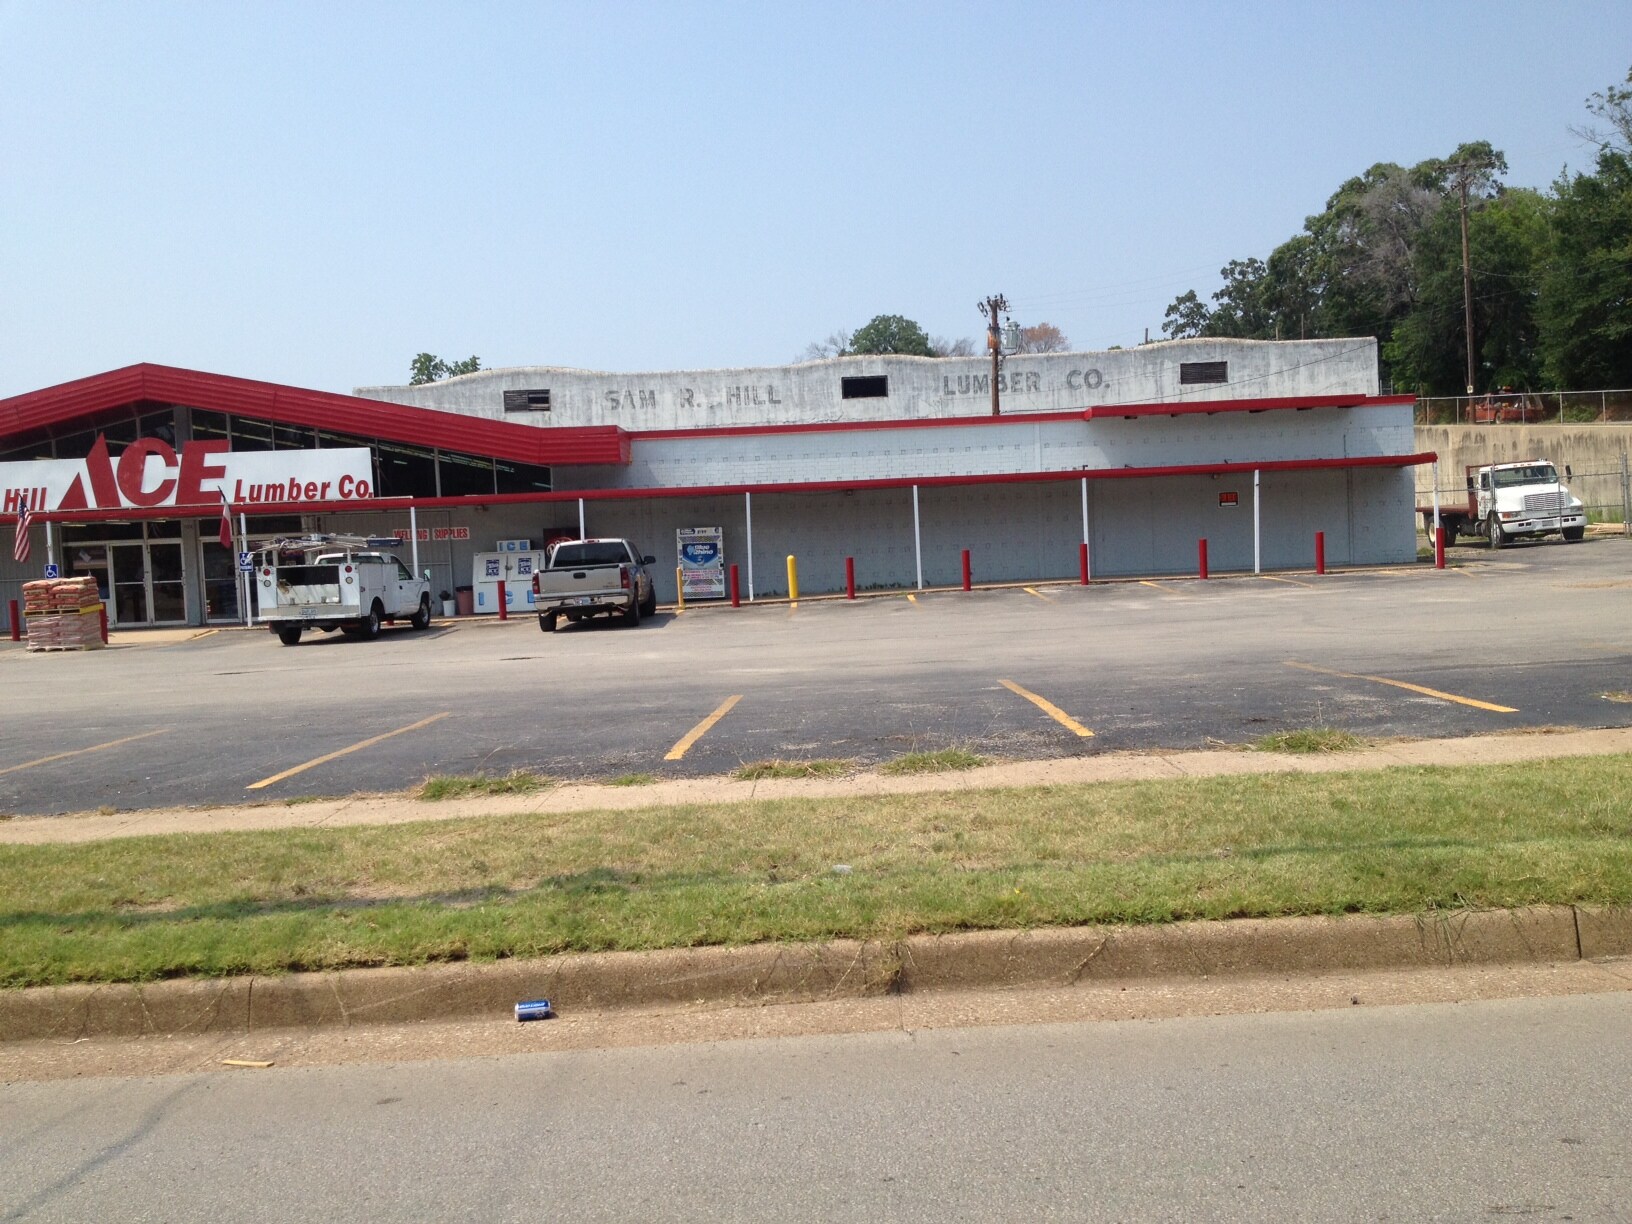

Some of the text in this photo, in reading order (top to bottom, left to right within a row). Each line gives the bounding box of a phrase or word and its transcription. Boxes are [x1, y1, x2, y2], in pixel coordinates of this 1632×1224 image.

[943, 368, 1110, 395] LUMBER CO.
[604, 384, 781, 410] SAM R. HILL
[57, 431, 230, 510] ACE
[3, 487, 47, 512] Hill
[234, 474, 374, 503] Lumber Co.
[434, 528, 468, 539] SUPPLIES
[499, 541, 528, 551] ICE
